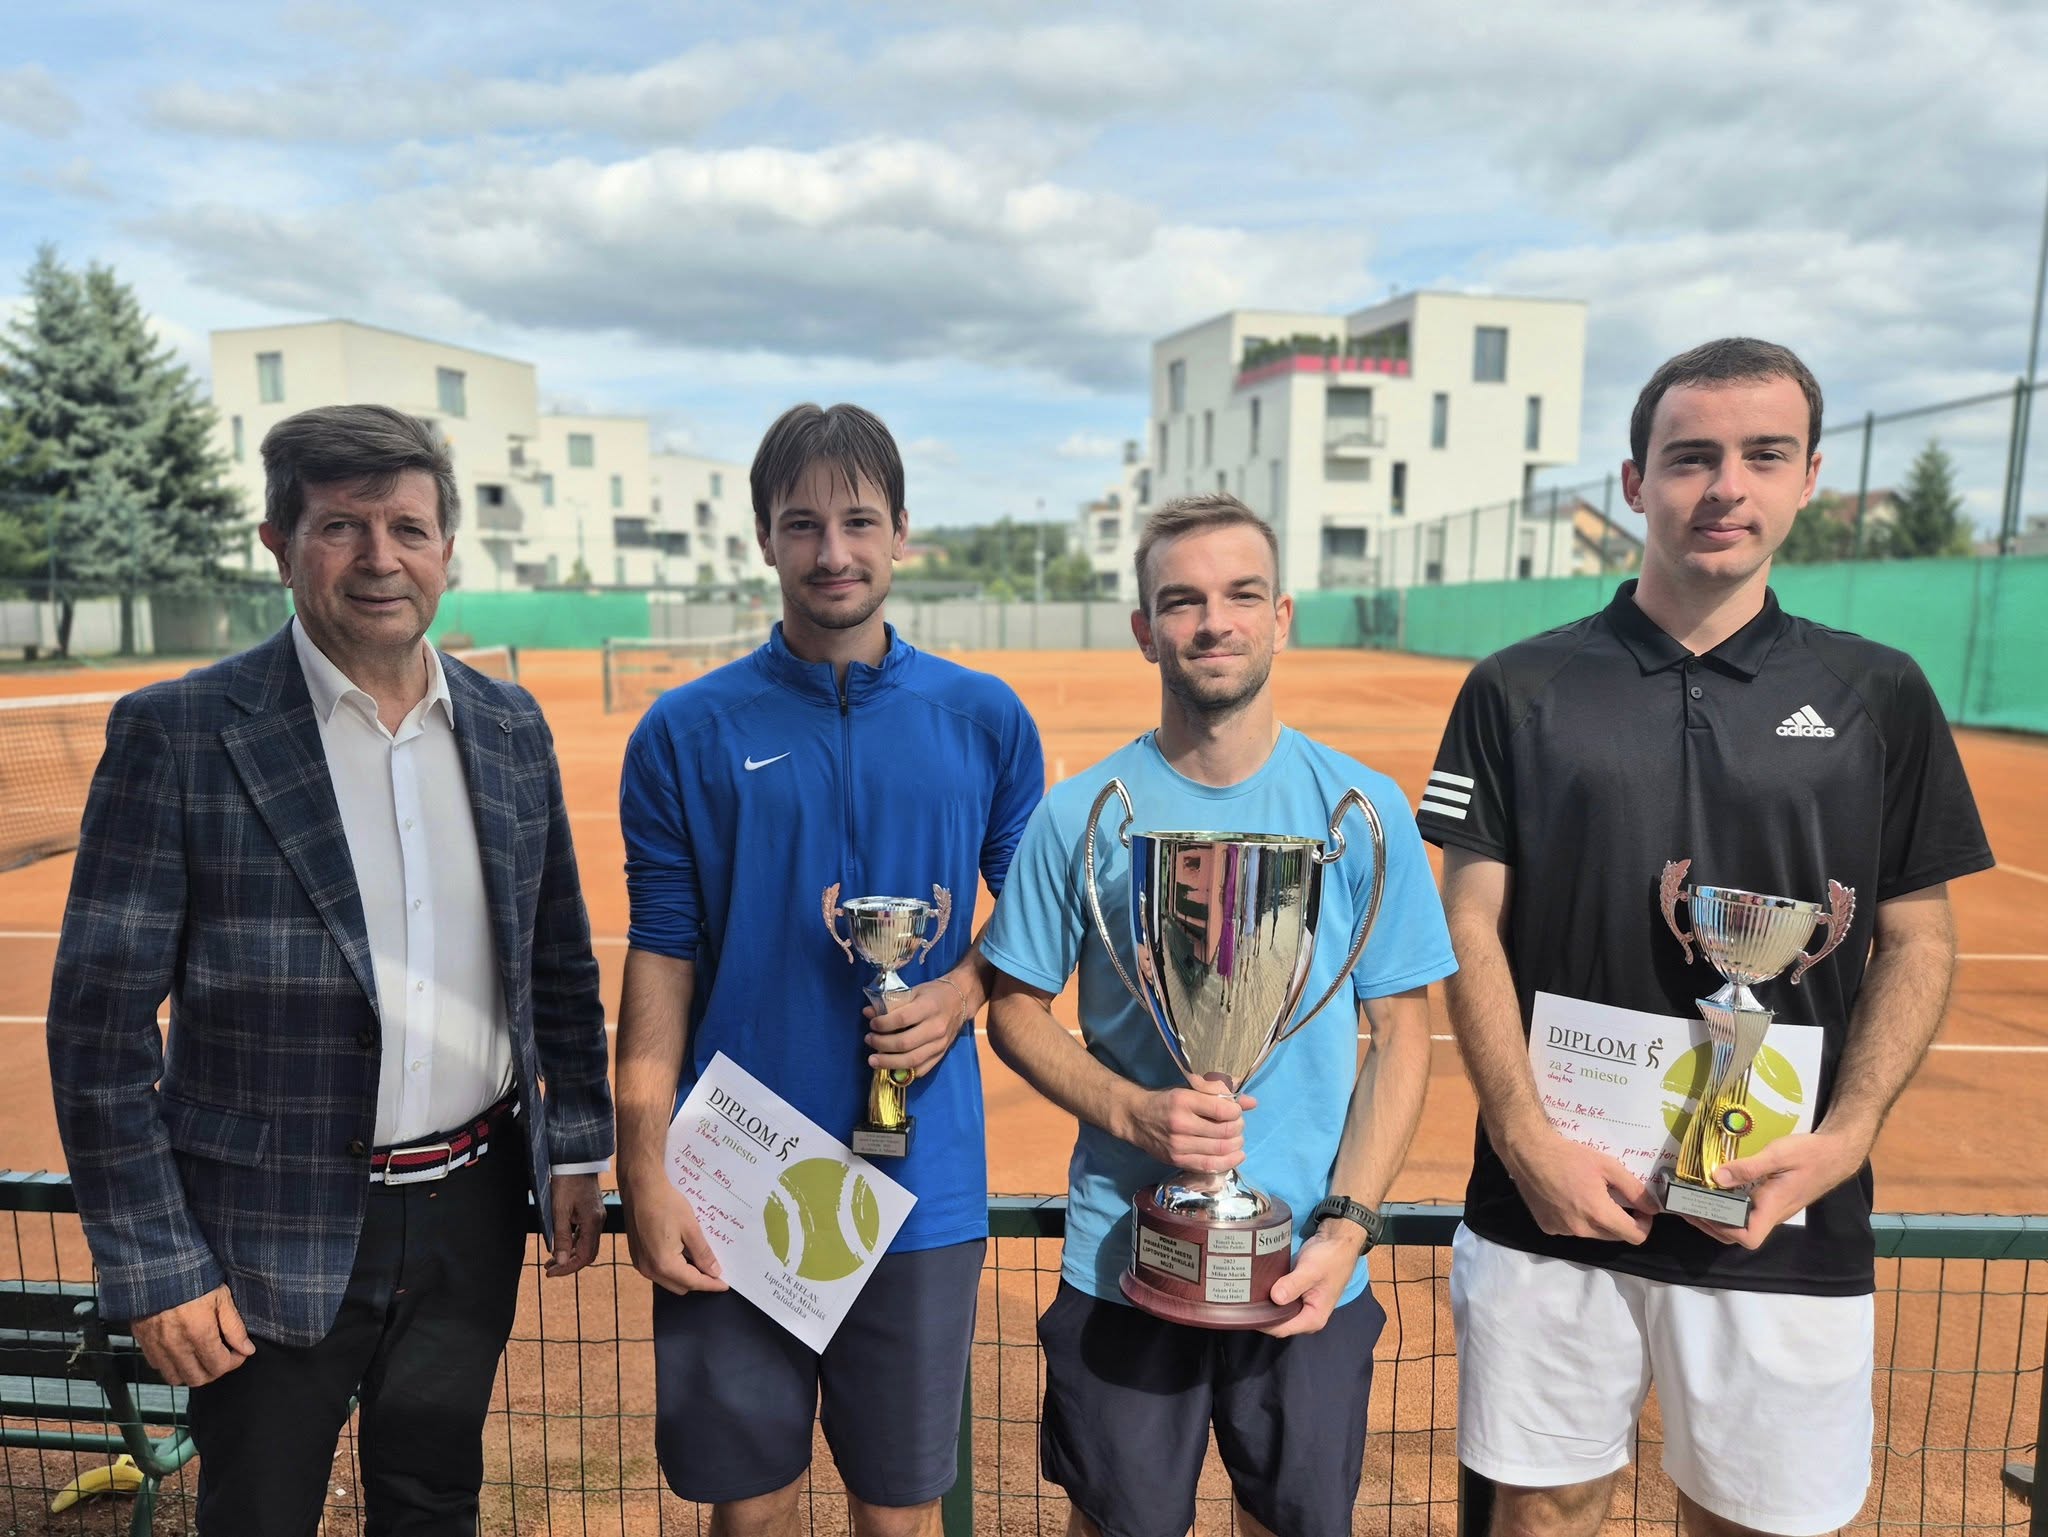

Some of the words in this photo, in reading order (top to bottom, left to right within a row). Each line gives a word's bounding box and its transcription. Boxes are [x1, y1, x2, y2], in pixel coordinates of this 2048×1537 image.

[1776, 725, 1835, 737] adidas
[1548, 1025, 1637, 1061] DIPLOM
[1549, 1060, 1561, 1071] za
[1580, 1066, 1628, 1086] miesto
[708, 1087, 779, 1148] DIPLOM
[699, 1117, 710, 1130] za
[721, 1135, 758, 1165] miesto
[1622, 1147, 1678, 1161] primátor
[764, 1272, 798, 1299] Liptovský
[798, 1297, 826, 1321] Mikuláš
